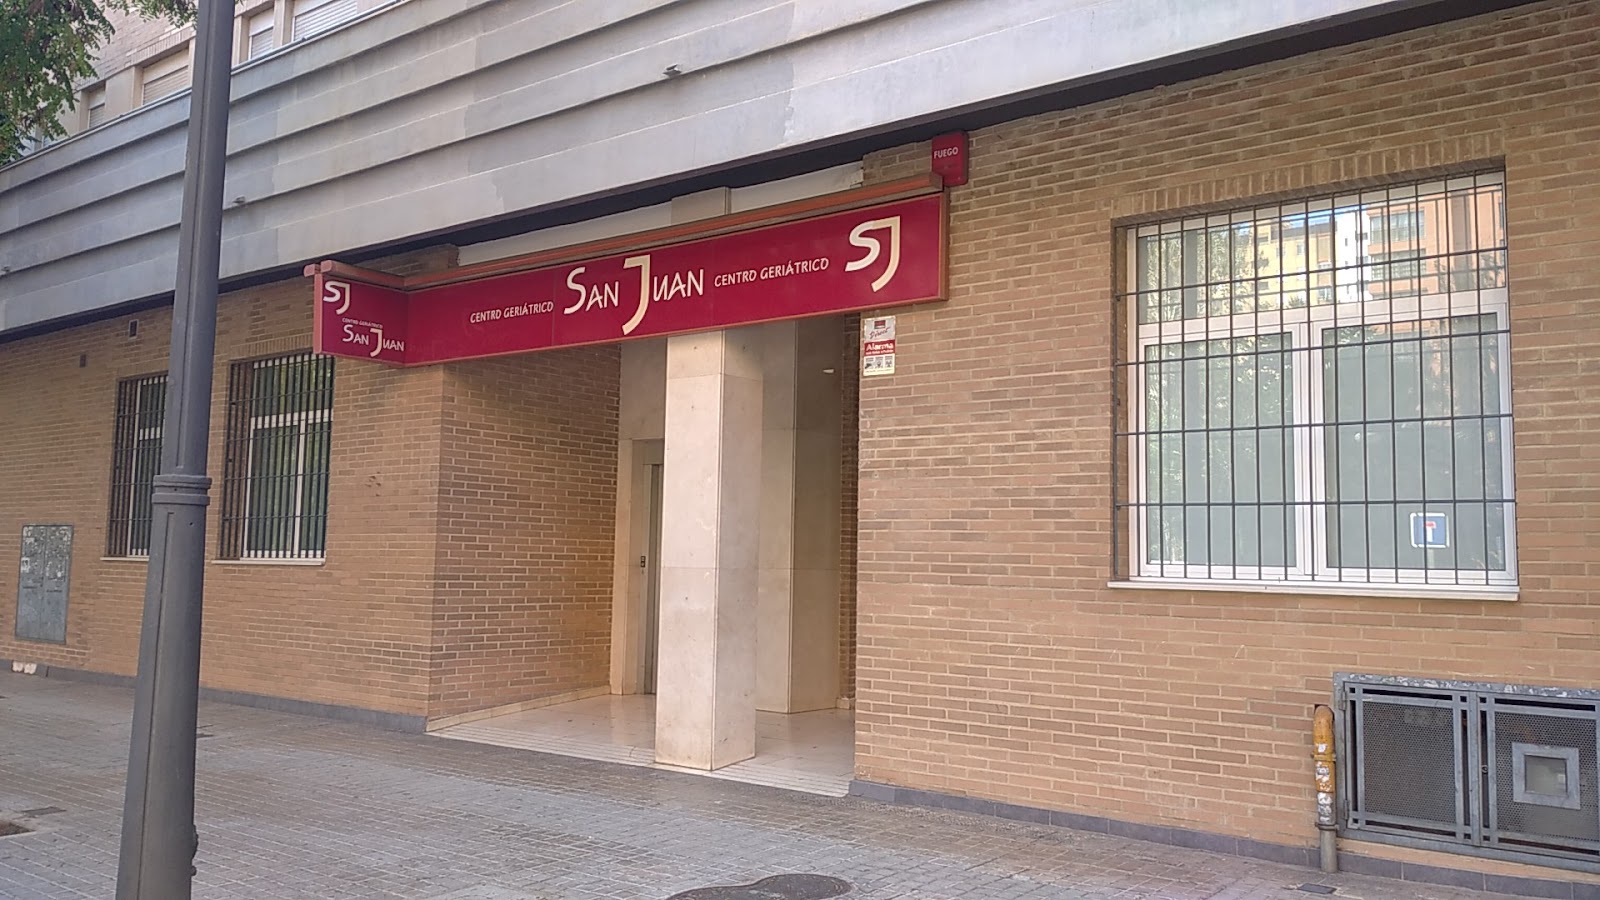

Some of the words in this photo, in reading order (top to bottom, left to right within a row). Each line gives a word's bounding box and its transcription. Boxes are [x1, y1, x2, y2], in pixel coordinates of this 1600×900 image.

[933, 146, 959, 159] FUEGO
[845, 215, 901, 293] SJ
[323, 280, 351, 316] SJ
[469, 309, 502, 324] CENTRO
[503, 301, 555, 319] GERIÁTRICO
[714, 269, 757, 287] CENTRO
[760, 256, 830, 280] GERIÁTRICO
[342, 317, 358, 325] CENTRO
[866, 343, 894, 351] Alarma
